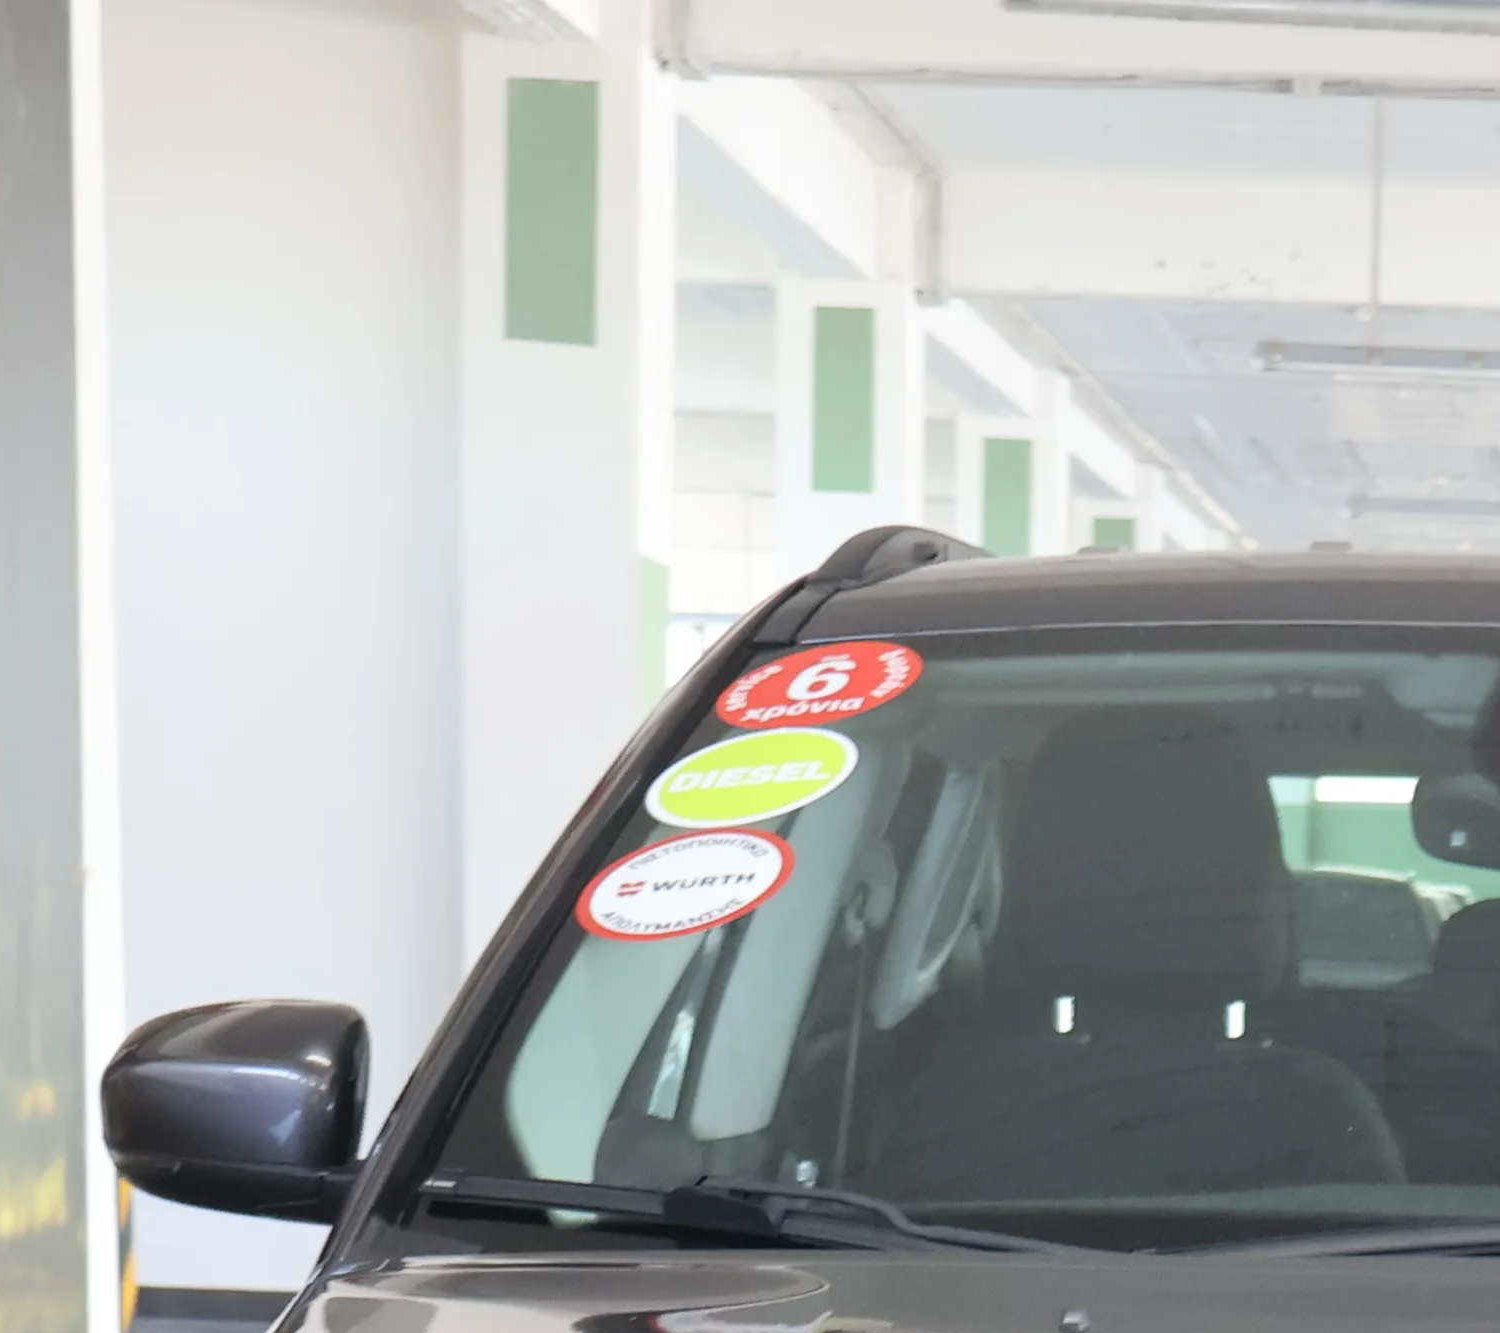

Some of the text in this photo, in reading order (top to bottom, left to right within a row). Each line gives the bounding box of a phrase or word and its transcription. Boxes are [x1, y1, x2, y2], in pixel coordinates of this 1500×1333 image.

[785, 659, 857, 701] 6
[740, 696, 865, 723] χρόνια
[667, 760, 830, 793] DIESEL
